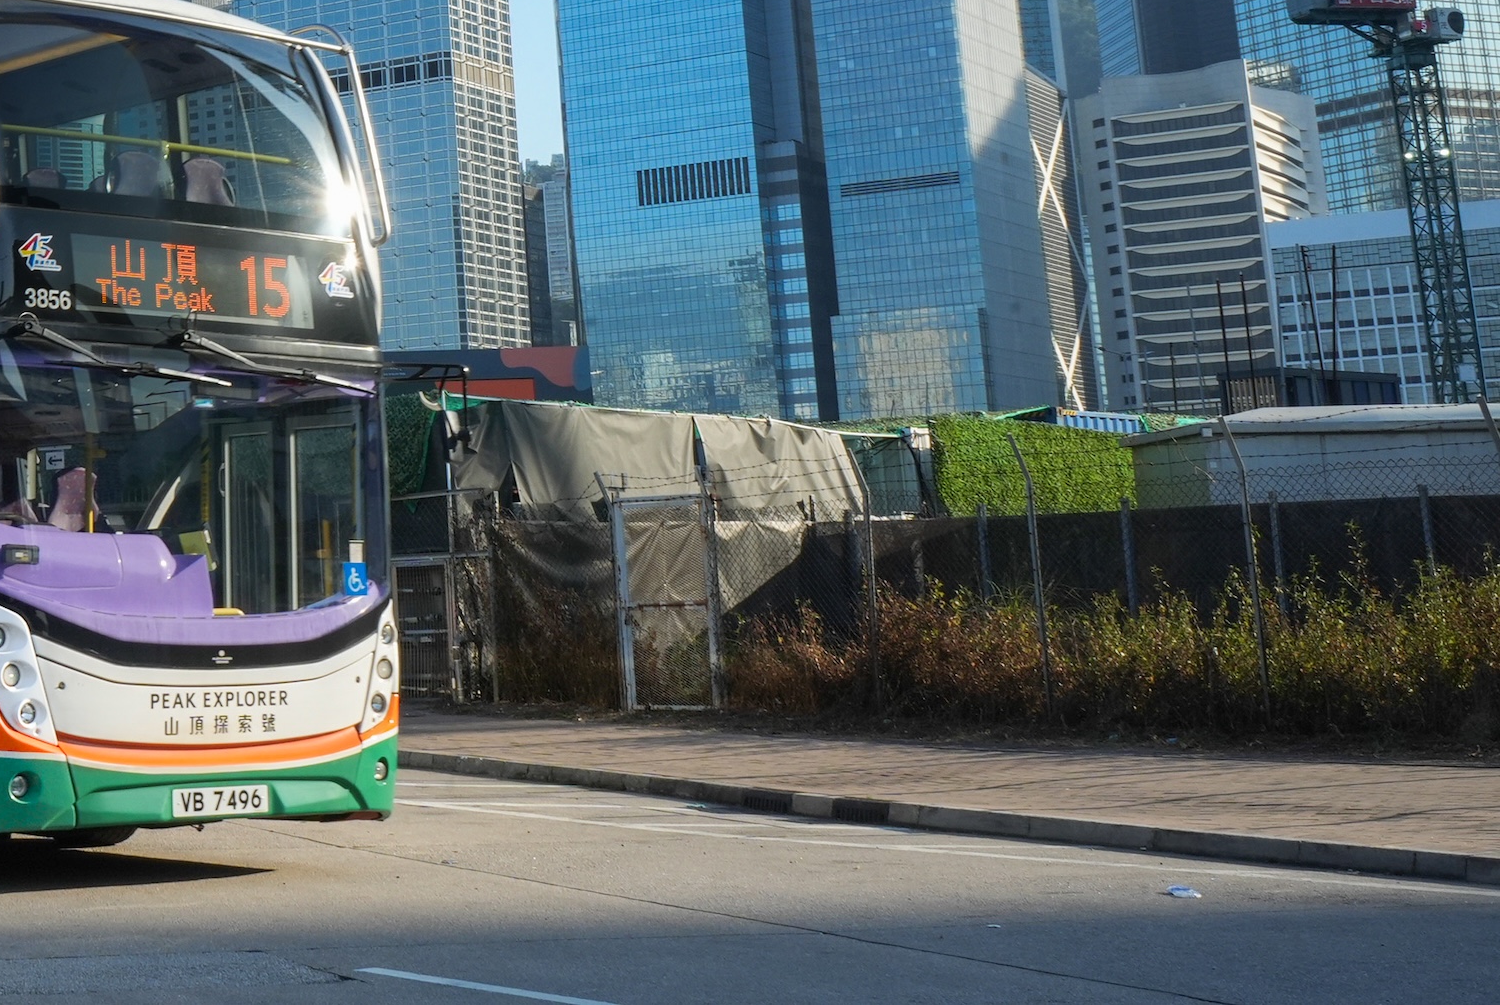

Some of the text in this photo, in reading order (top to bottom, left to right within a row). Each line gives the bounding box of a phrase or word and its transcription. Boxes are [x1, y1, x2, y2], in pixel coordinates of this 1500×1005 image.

[110, 239, 199, 286] 山頂
[24, 287, 72, 310] 3856
[96, 278, 216, 313] The Peak
[240, 256, 291, 318] 15
[150, 690, 289, 709] PEAK EXPLORER
[164, 713, 277, 736] 山頂探索號
[180, 788, 262, 813] VB 7496
